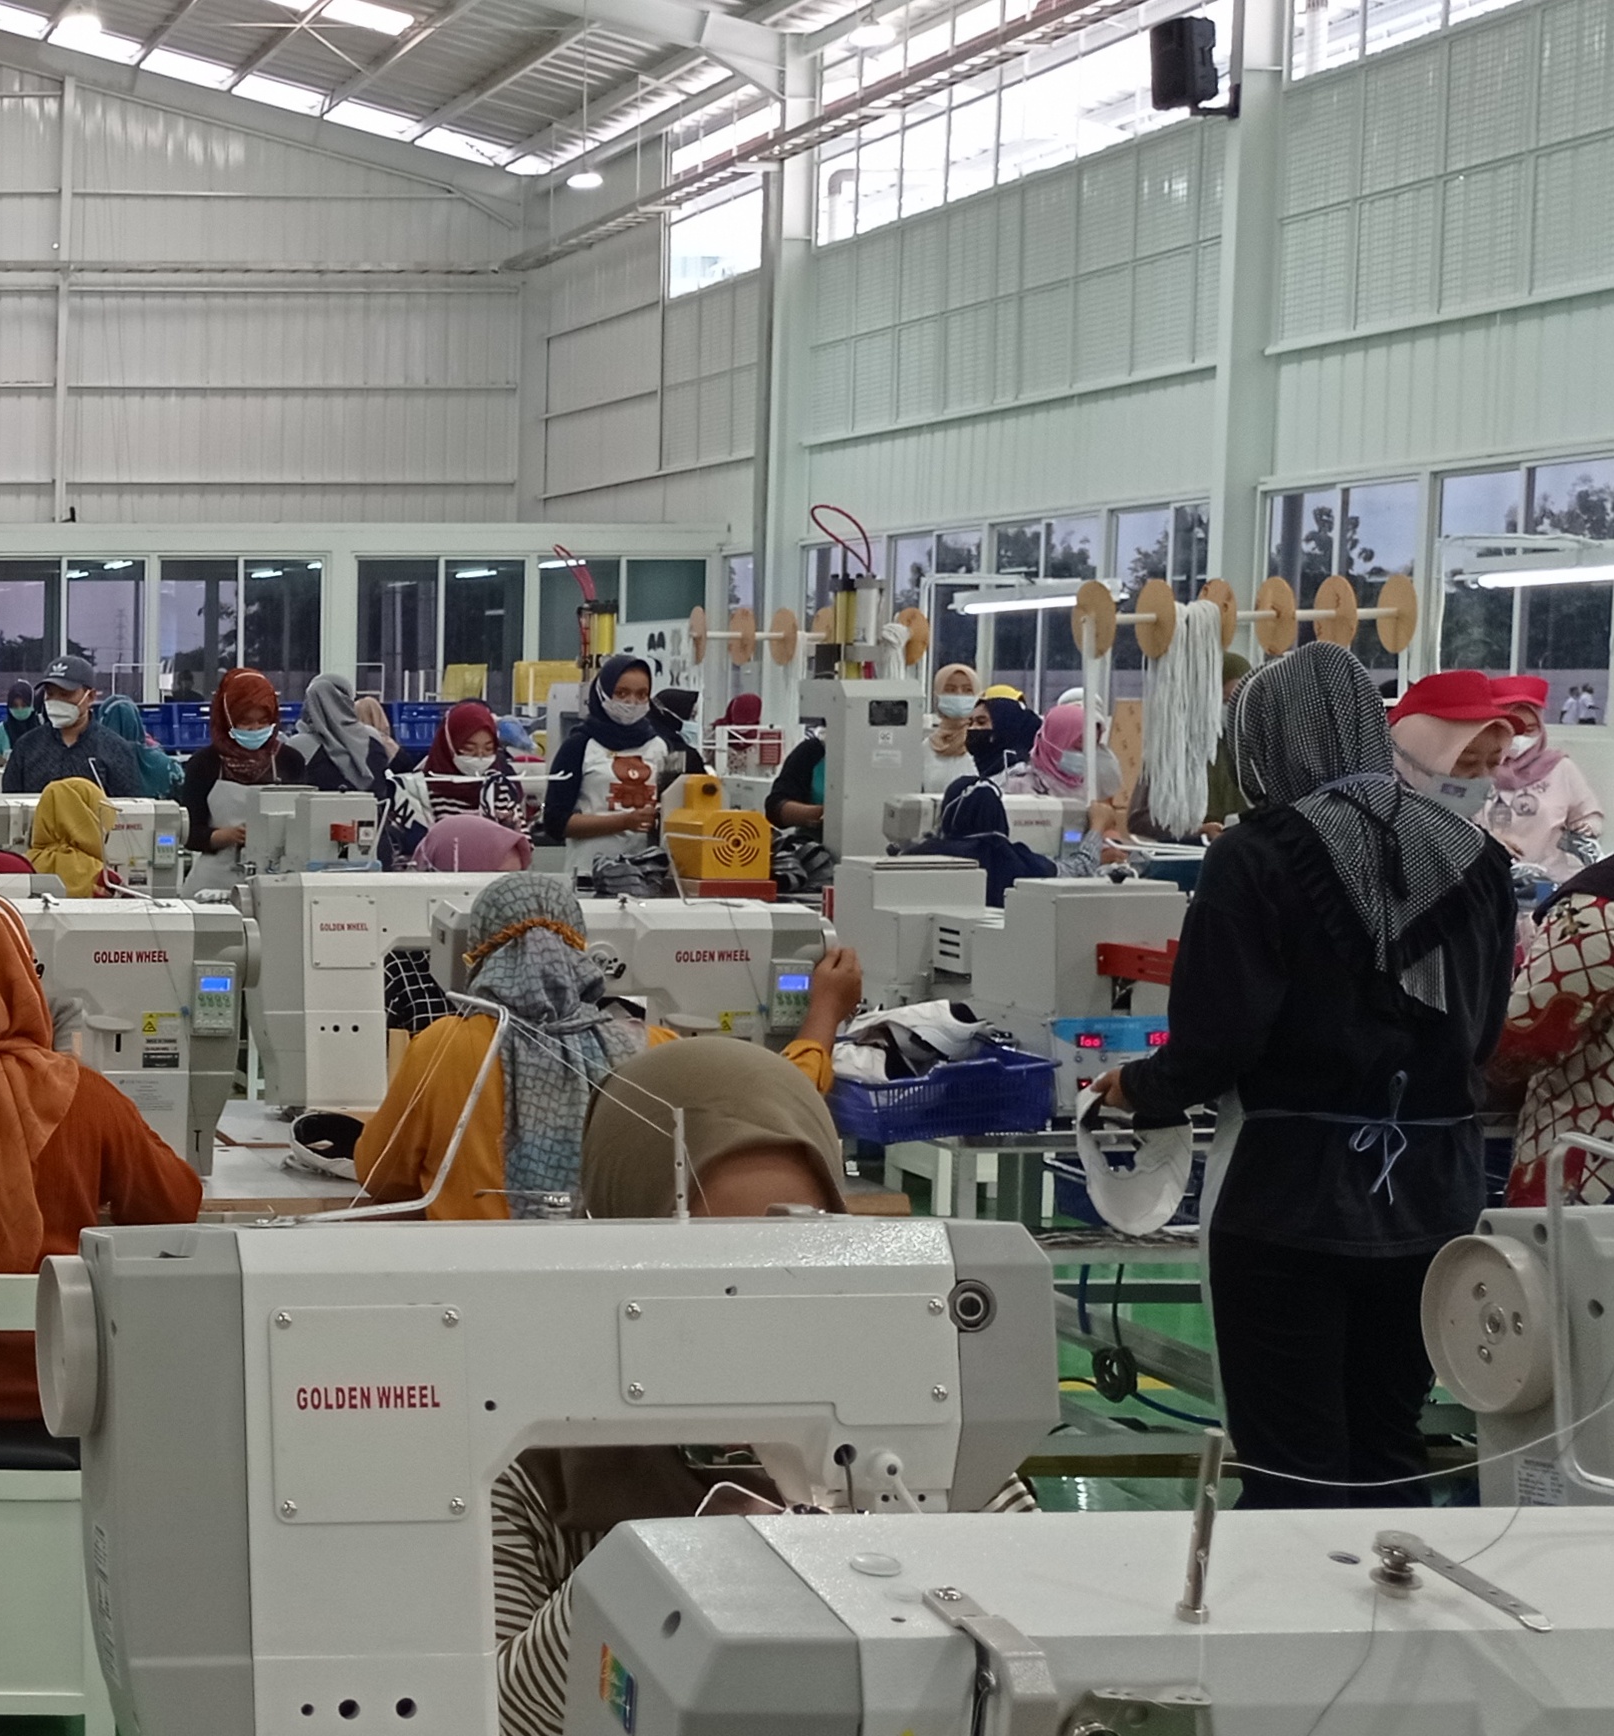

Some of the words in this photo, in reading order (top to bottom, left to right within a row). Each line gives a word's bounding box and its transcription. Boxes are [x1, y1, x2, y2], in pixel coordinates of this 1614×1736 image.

[319, 923, 346, 931] GOLDEN
[346, 923, 369, 931] WHEEL
[93, 951, 134, 964] GOLDEN
[135, 951, 169, 963] WHEEL
[675, 950, 716, 963] GOLDEN
[717, 950, 751, 962] WHEEL
[296, 1387, 371, 1411] GOLDEN
[377, 1385, 441, 1409] WHEEL
